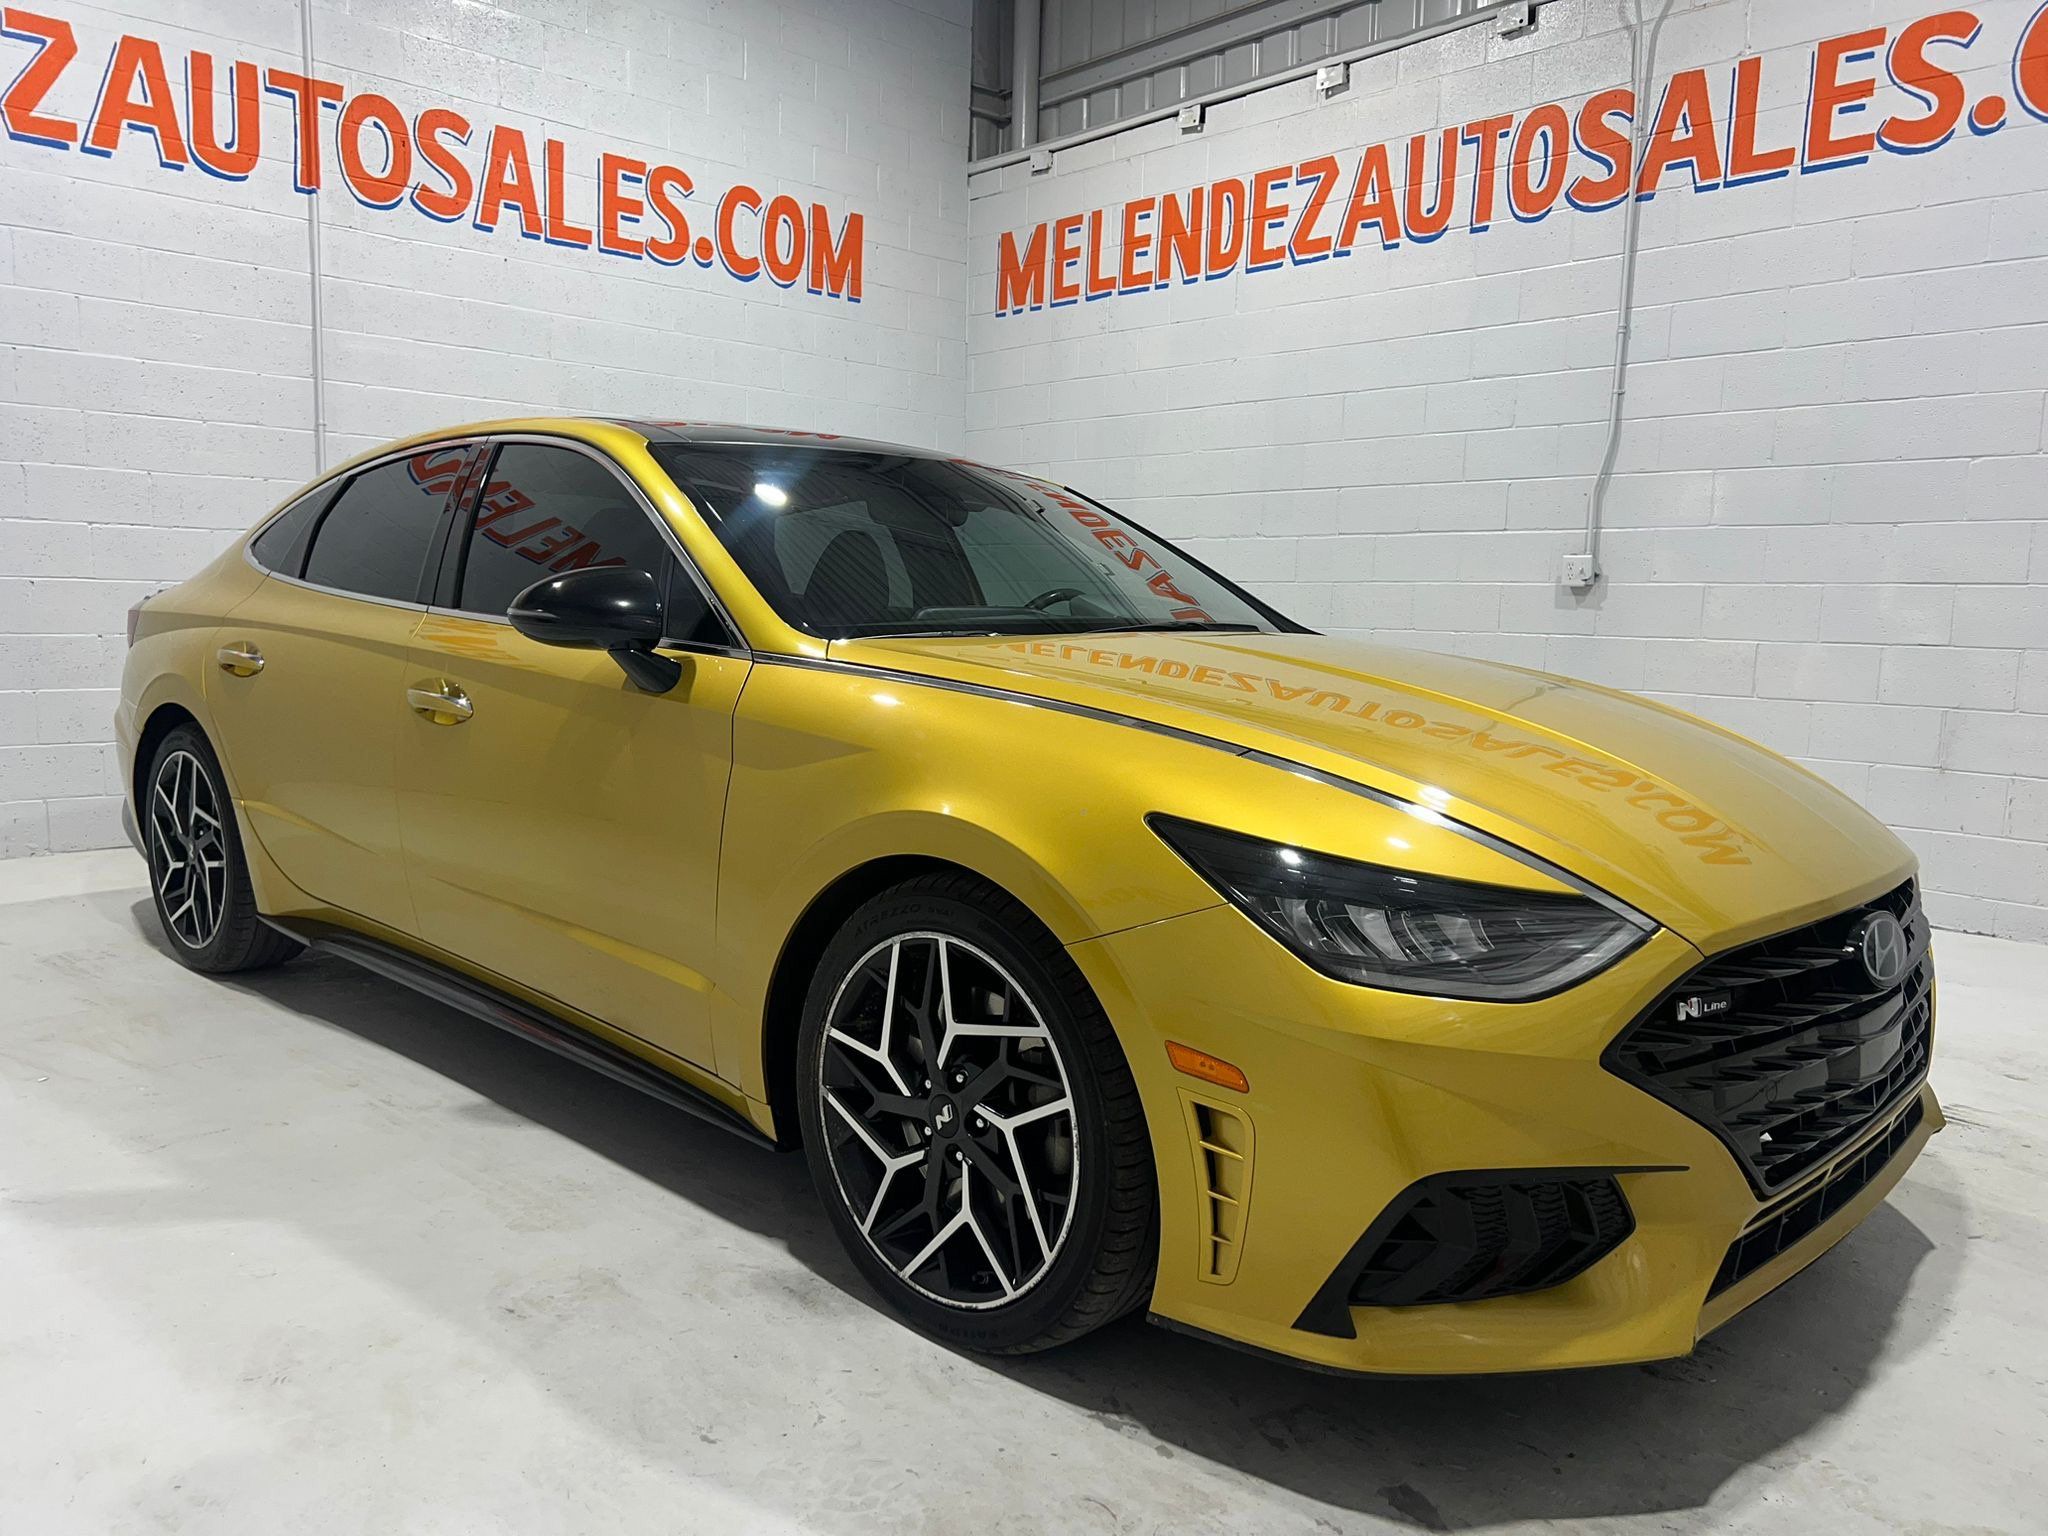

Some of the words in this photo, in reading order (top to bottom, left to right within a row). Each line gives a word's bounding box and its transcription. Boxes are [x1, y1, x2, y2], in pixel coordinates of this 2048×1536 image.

[0, 7, 864, 303] ZAUTOSALES.COM
[1677, 997, 1702, 1021] N
[1704, 1001, 1727, 1013] Line
